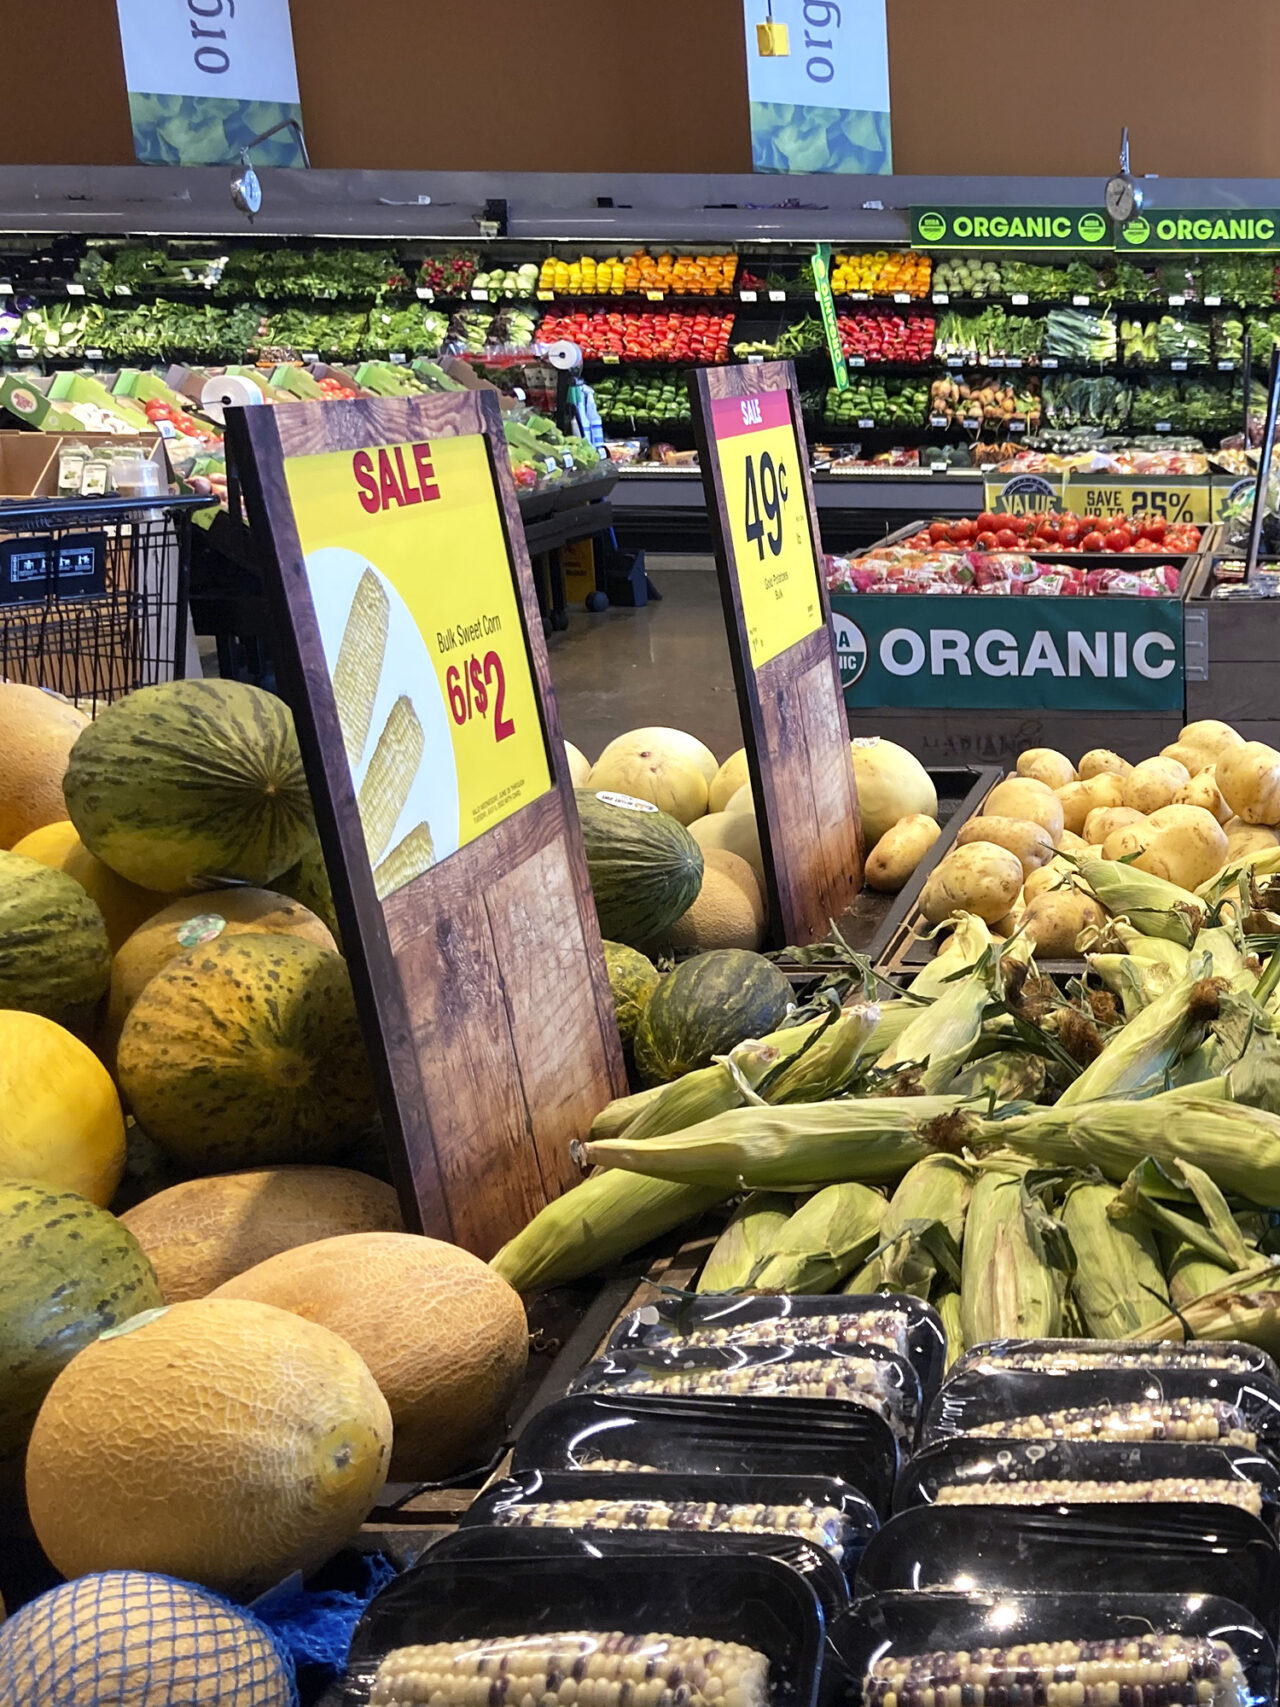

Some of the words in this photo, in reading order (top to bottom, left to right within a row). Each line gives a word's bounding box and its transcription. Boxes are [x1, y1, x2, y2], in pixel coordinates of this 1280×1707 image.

[953, 216, 1072, 238] ORGANIC
[1156, 219, 1275, 241] ORGANIC
[820, 282, 842, 363] ORGANIC
[741, 399, 763, 427] SALE
[353, 443, 441, 514] SALE
[1001, 494, 1057, 515] VALUE
[1087, 491, 1122, 507] SAVE
[436, 631, 458, 654] Bulk
[457, 623, 483, 646] Sweet
[482, 614, 502, 636] Corn
[879, 627, 1177, 680] ORGANIC
[446, 650, 516, 743] 6/$2
